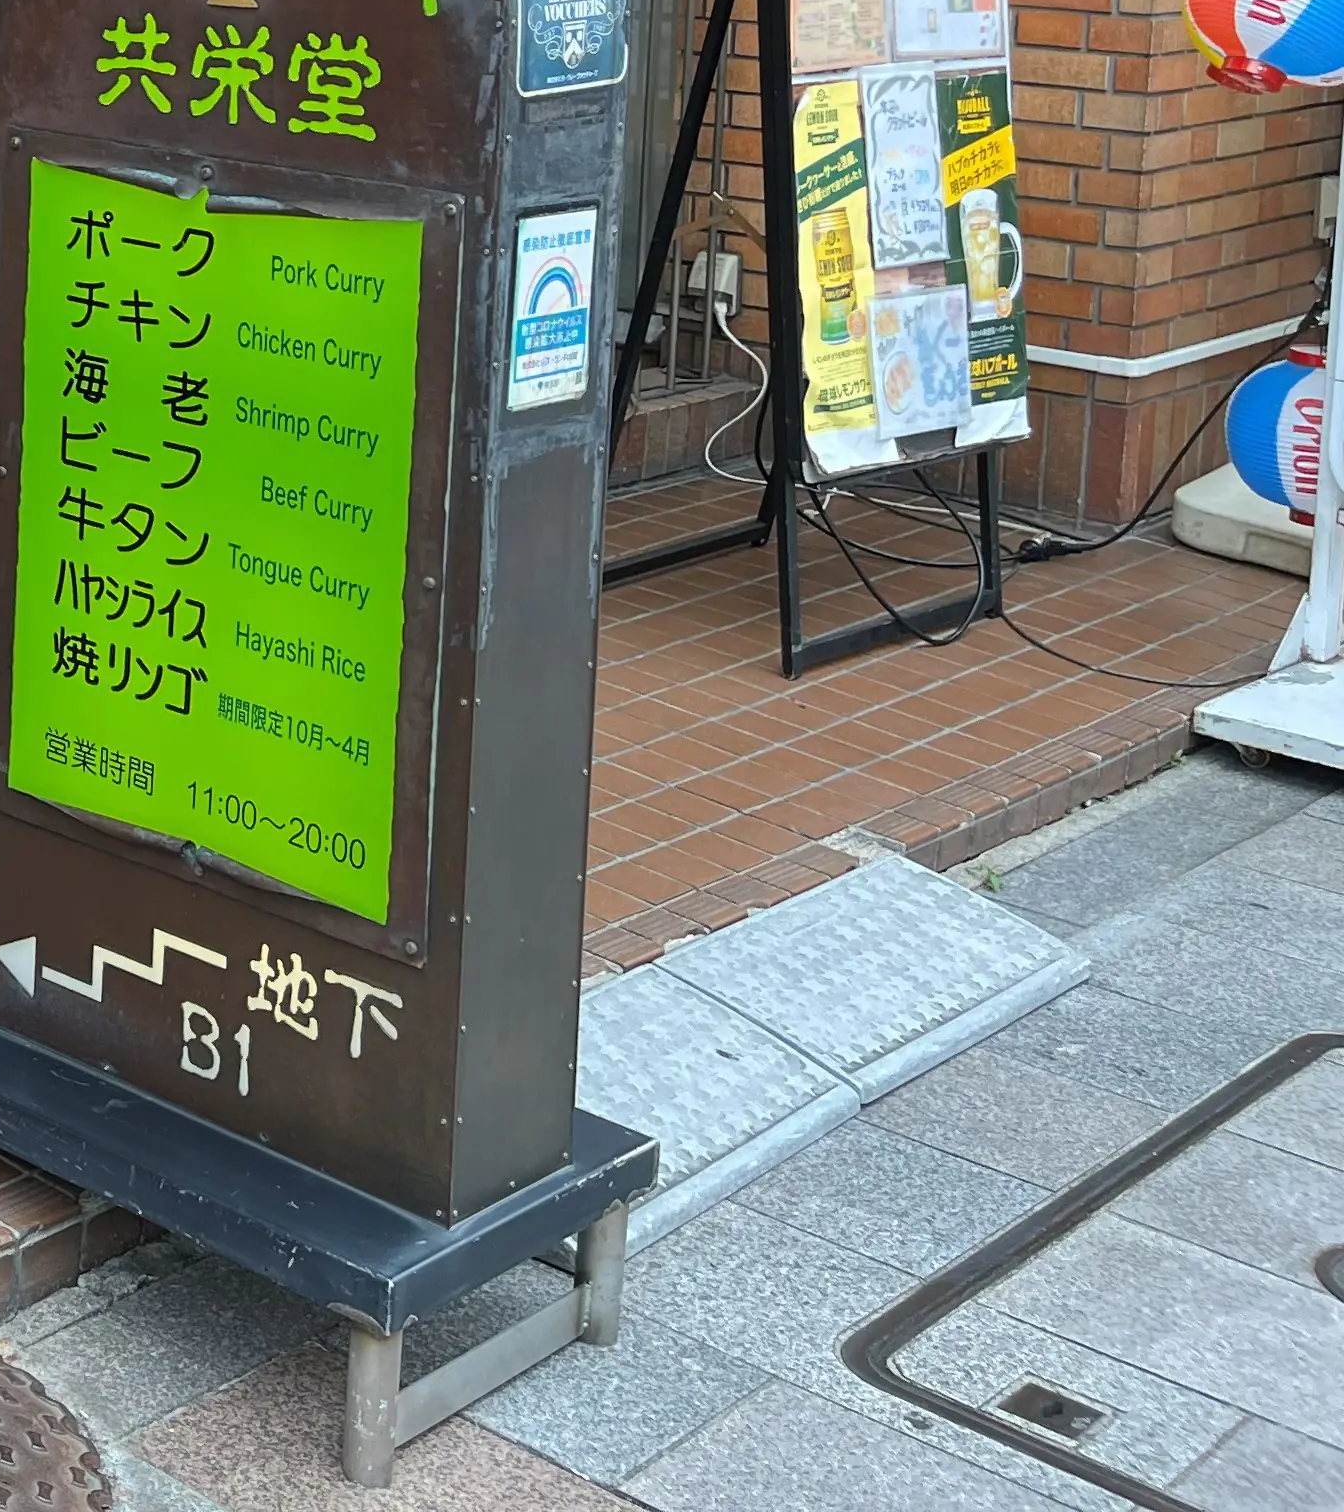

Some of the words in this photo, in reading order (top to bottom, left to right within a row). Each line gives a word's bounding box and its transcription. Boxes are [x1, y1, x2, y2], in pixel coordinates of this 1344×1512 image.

[96, 12, 382, 141] 共栄堂
[66, 209, 215, 277] ポーク
[271, 255, 318, 289] Pork
[324, 262, 386, 303] Curry
[66, 281, 211, 349] チキン
[237, 322, 316, 363] Chicken
[323, 338, 383, 379] Curry
[62, 347, 210, 427] 海老
[61, 416, 202, 490] ビーフ
[235, 396, 310, 438] Shrimp
[317, 415, 380, 458] Curry
[58, 485, 210, 566] 牛タン
[260, 476, 308, 512] Beef
[313, 489, 374, 533] Curry
[54, 558, 209, 649] ハヤシライス
[227, 543, 303, 588] Tongue
[310, 566, 370, 610] Curry
[52, 626, 209, 716] 焼リンゴ
[235, 621, 315, 668] Hayashi
[321, 644, 366, 683] Rice
[44, 725, 155, 796] 営業時間
[247, 944, 404, 1059] 地下
[180, 1001, 251, 1097] B1
